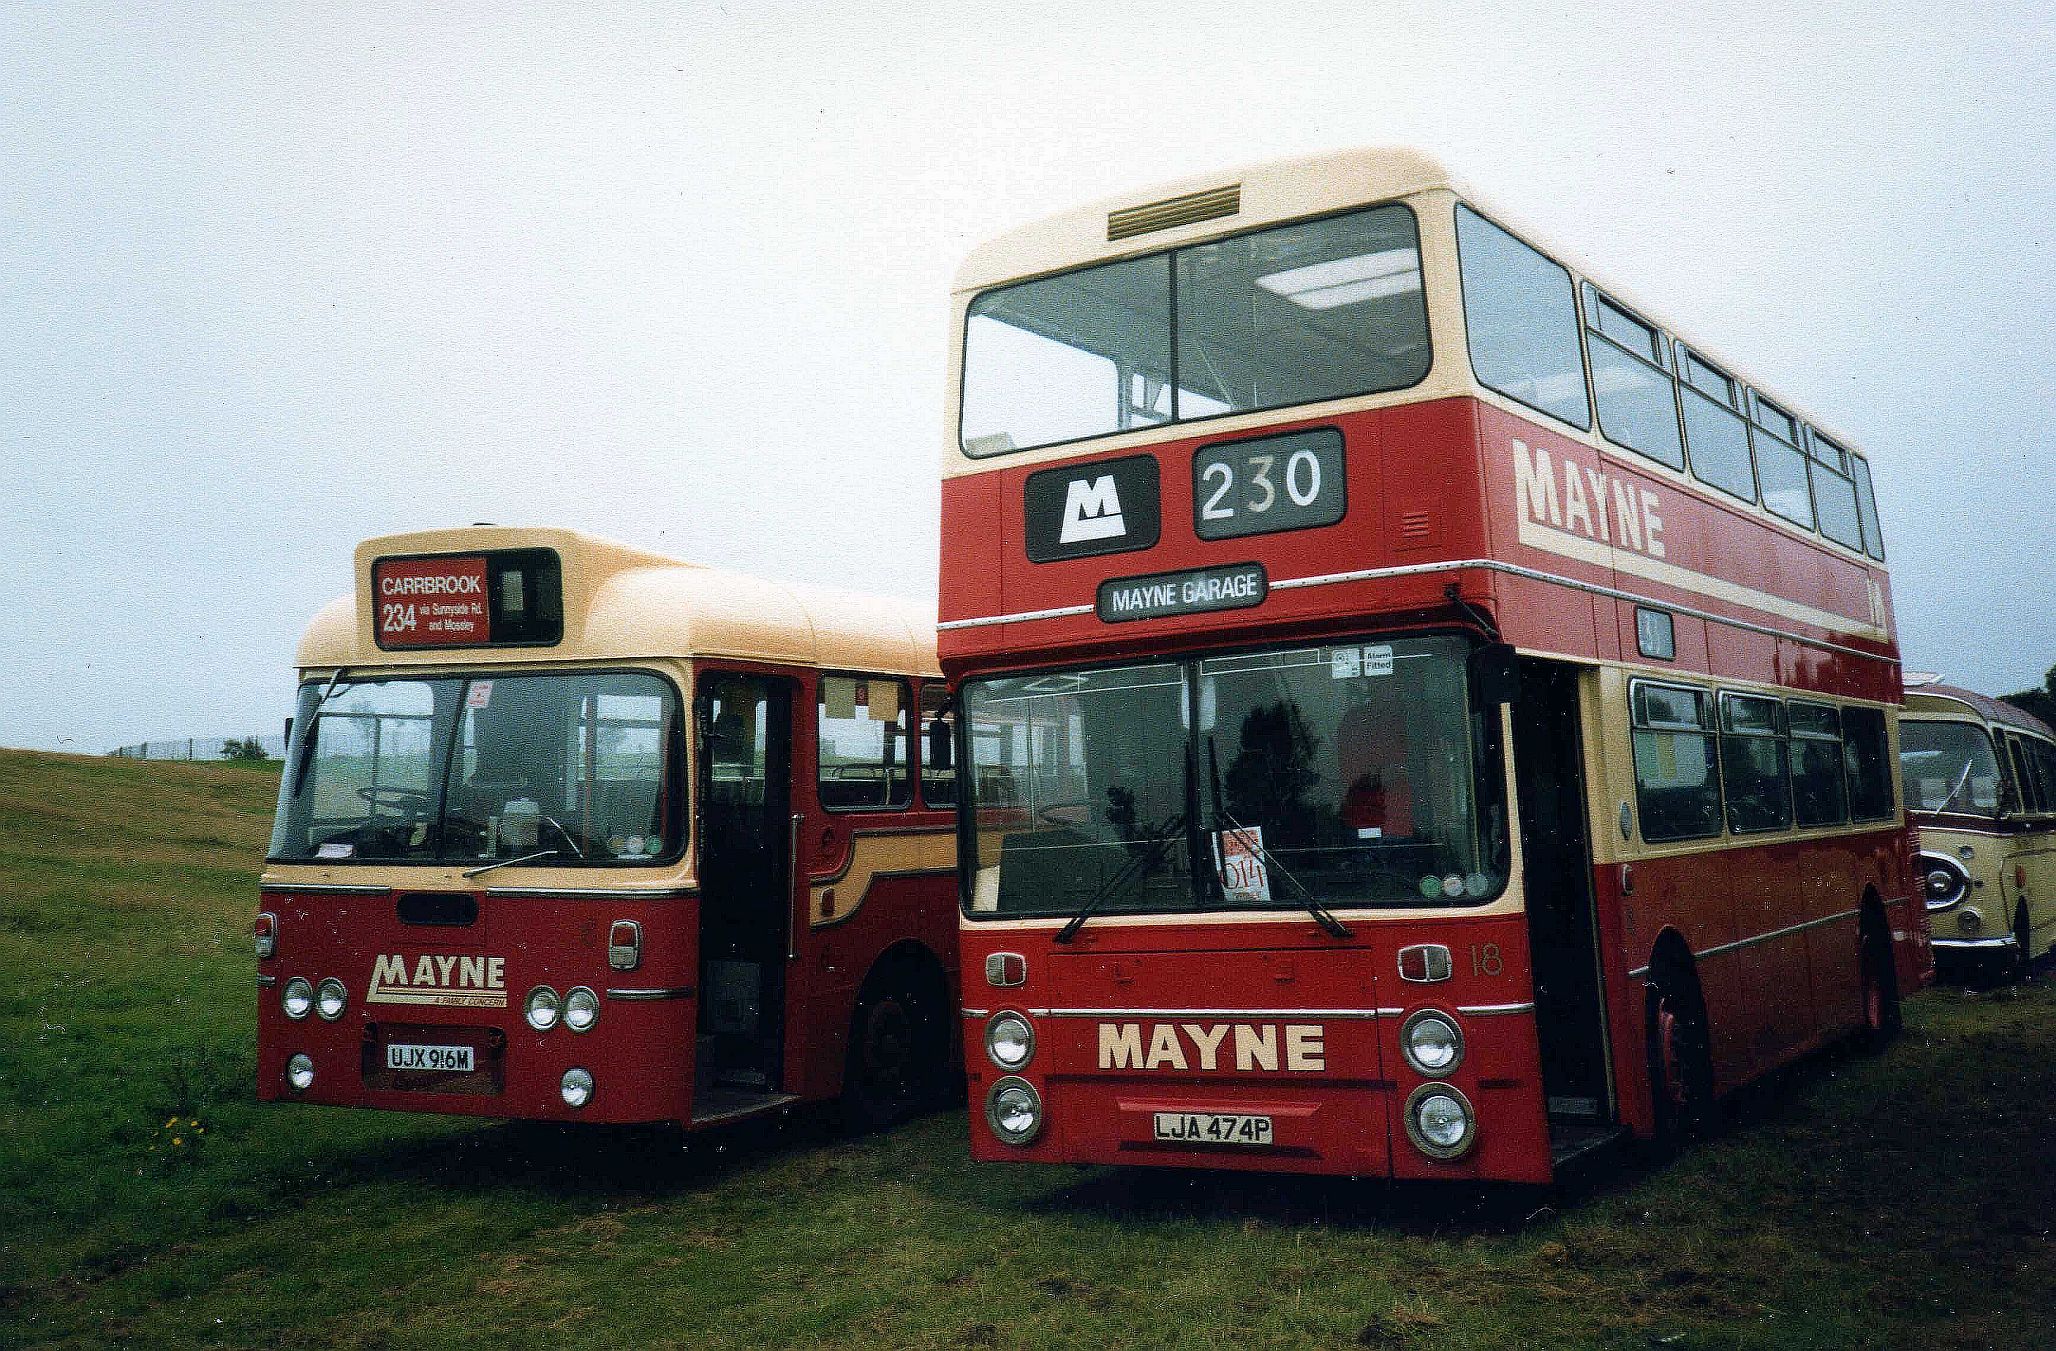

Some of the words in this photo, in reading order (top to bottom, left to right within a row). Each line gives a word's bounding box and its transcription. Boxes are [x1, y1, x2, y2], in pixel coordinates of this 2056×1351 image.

[1202, 449, 1321, 521] 230
[1512, 437, 1666, 558] MAYNE
[1059, 474, 1127, 544] M
[381, 575, 481, 595] CARRBROOK
[1112, 584, 1177, 612] MAYNE
[1183, 573, 1258, 603] GARAGE
[383, 603, 417, 632] 234
[1367, 661, 1391, 669] Fitted
[374, 954, 506, 989] MAYNE
[1471, 943, 1503, 977] 18
[391, 1048, 426, 1067] UJX
[429, 1049, 469, 1069] 916M
[1098, 1023, 1325, 1071] MAYNE
[1156, 1115, 1200, 1138] LJA
[1207, 1117, 1270, 1141] 474P
